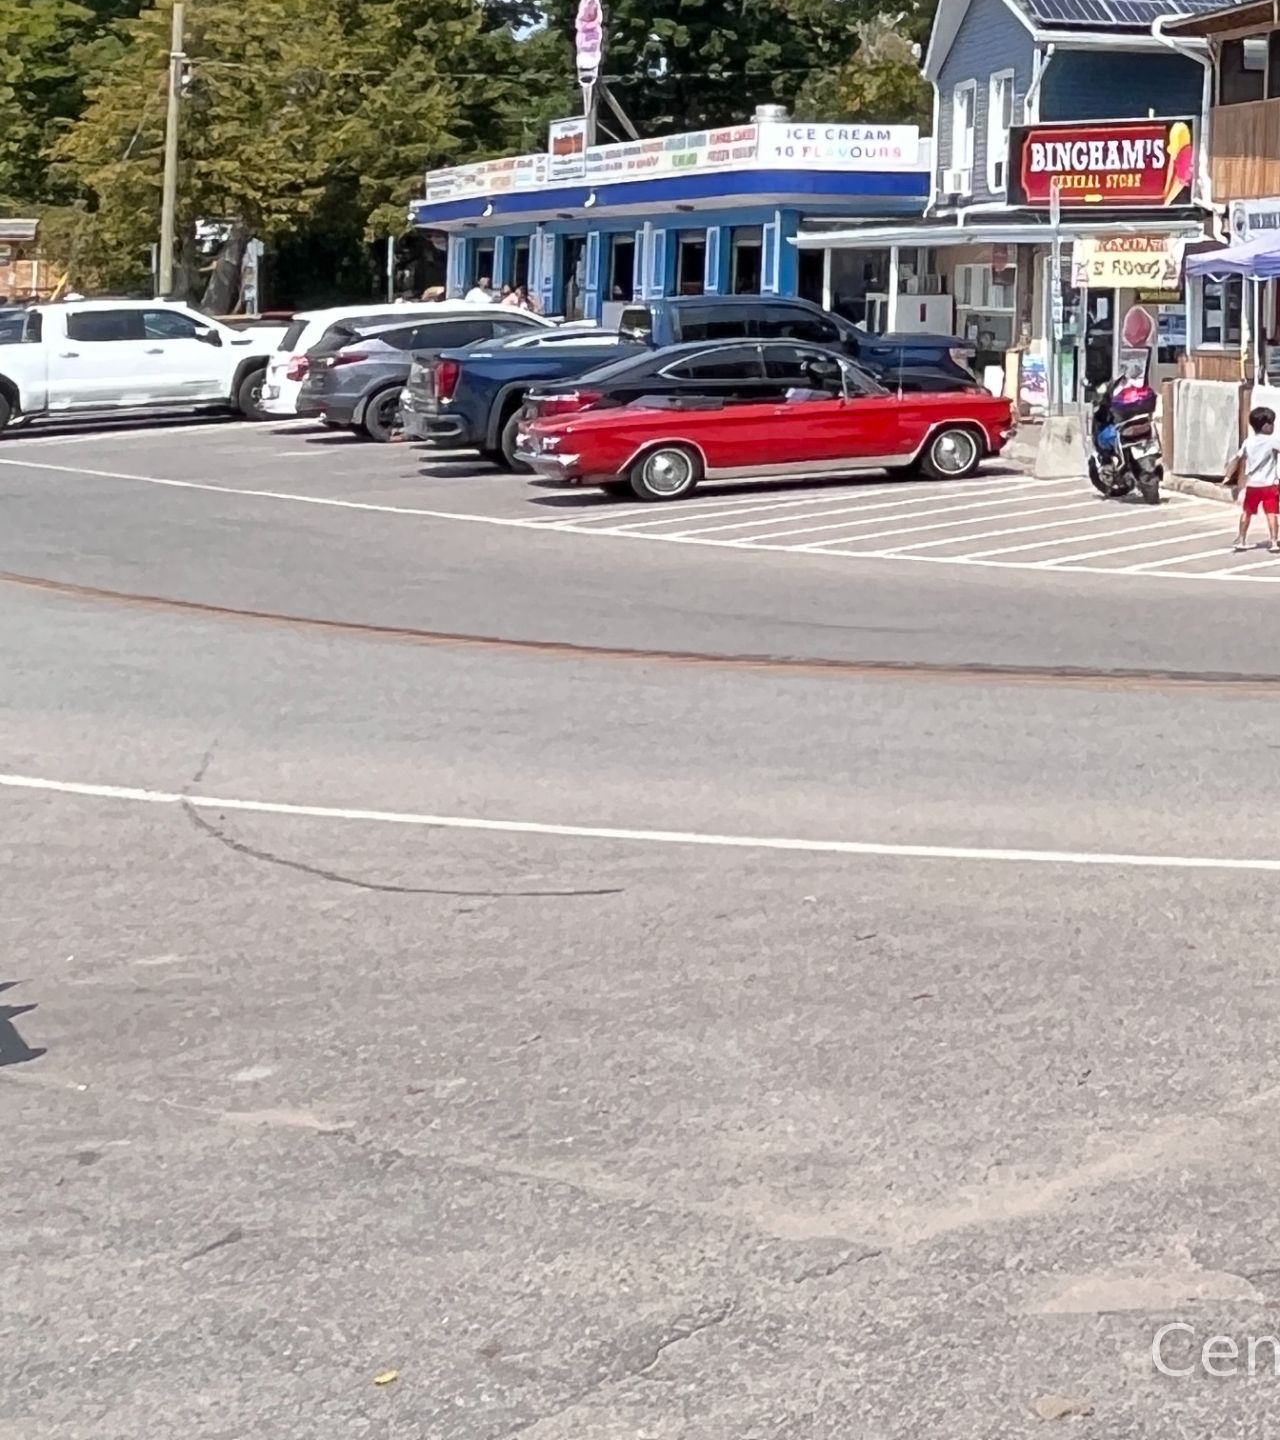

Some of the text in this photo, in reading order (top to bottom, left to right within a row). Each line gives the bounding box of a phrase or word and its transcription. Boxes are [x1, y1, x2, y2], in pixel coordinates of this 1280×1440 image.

[786, 128, 891, 140] ICE CREAM
[802, 146, 902, 158] FLAVOURS
[1030, 138, 1165, 173] BINGHAM'S
